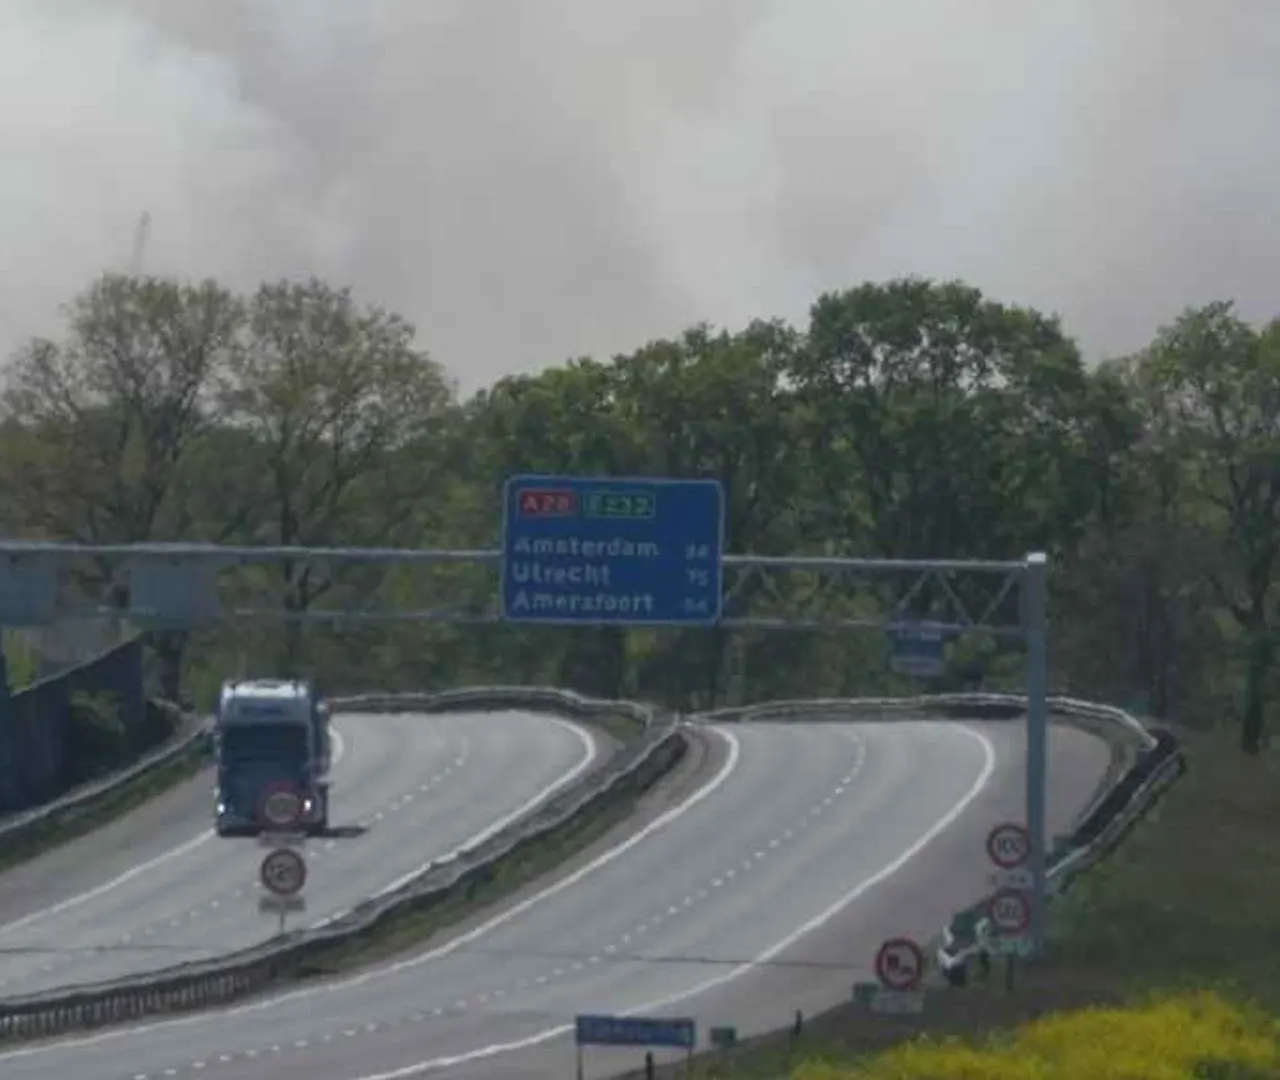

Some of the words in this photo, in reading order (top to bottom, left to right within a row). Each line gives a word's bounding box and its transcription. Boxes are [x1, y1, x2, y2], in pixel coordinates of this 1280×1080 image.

[521, 495, 571, 513] A28
[513, 536, 660, 557] Amsterdam
[511, 561, 611, 586] Utrecht
[511, 589, 656, 614] Amersfoort
